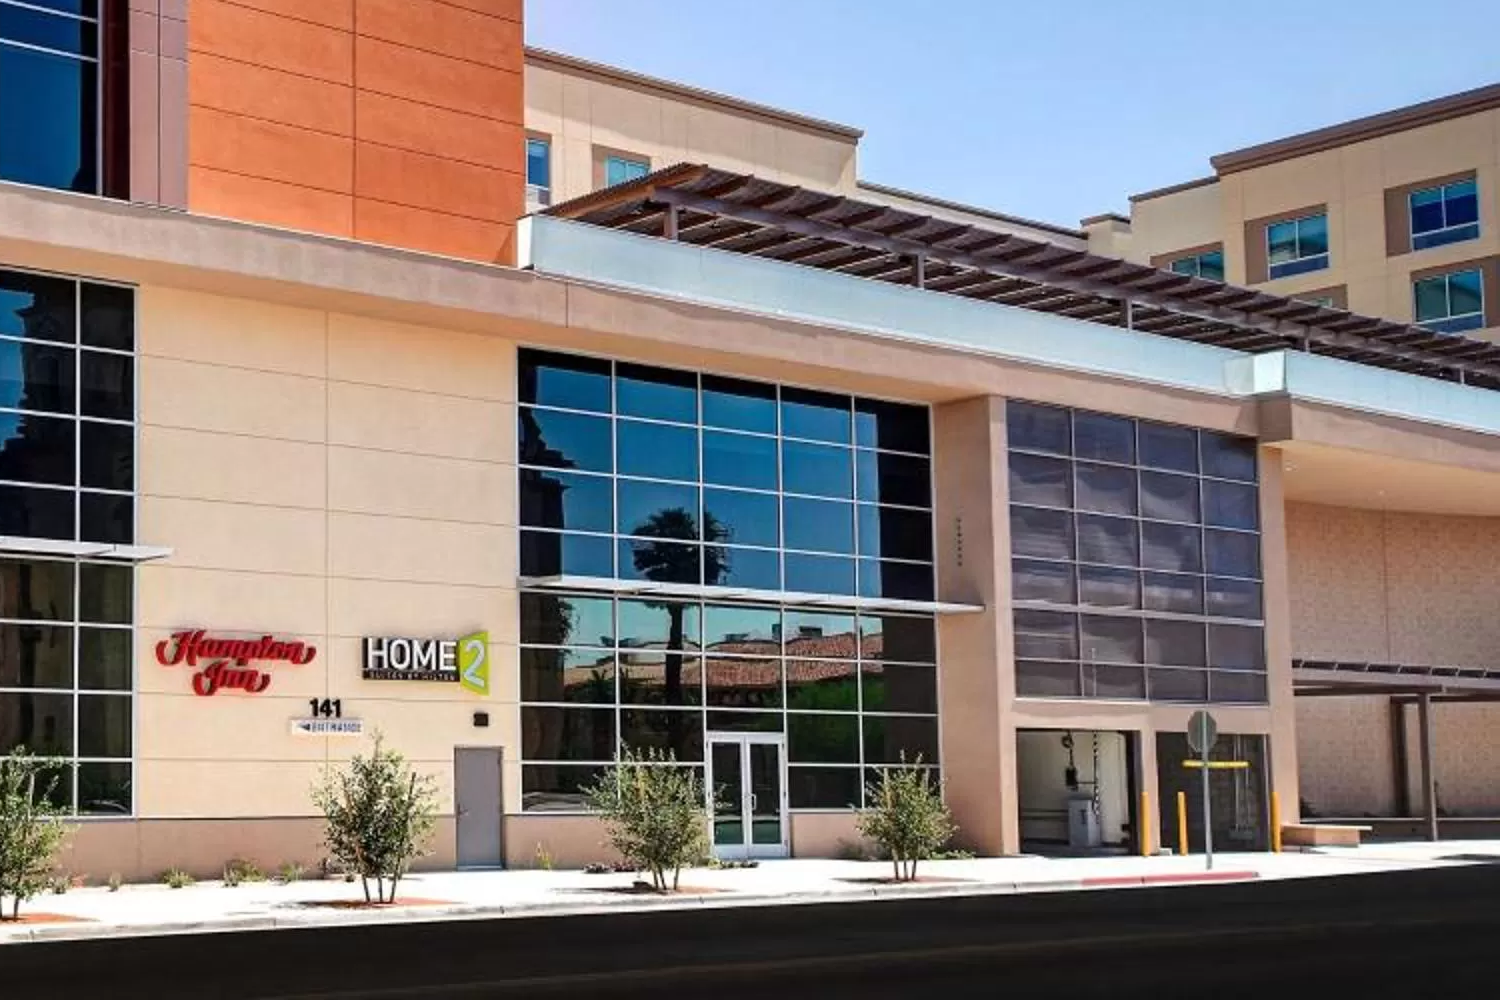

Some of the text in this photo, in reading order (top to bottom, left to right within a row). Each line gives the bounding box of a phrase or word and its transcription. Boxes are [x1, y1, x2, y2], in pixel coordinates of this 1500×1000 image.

[156, 630, 317, 666] Hampton
[367, 637, 485, 688] HOME 2
[192, 661, 270, 696] Inn
[309, 697, 341, 718] 141
